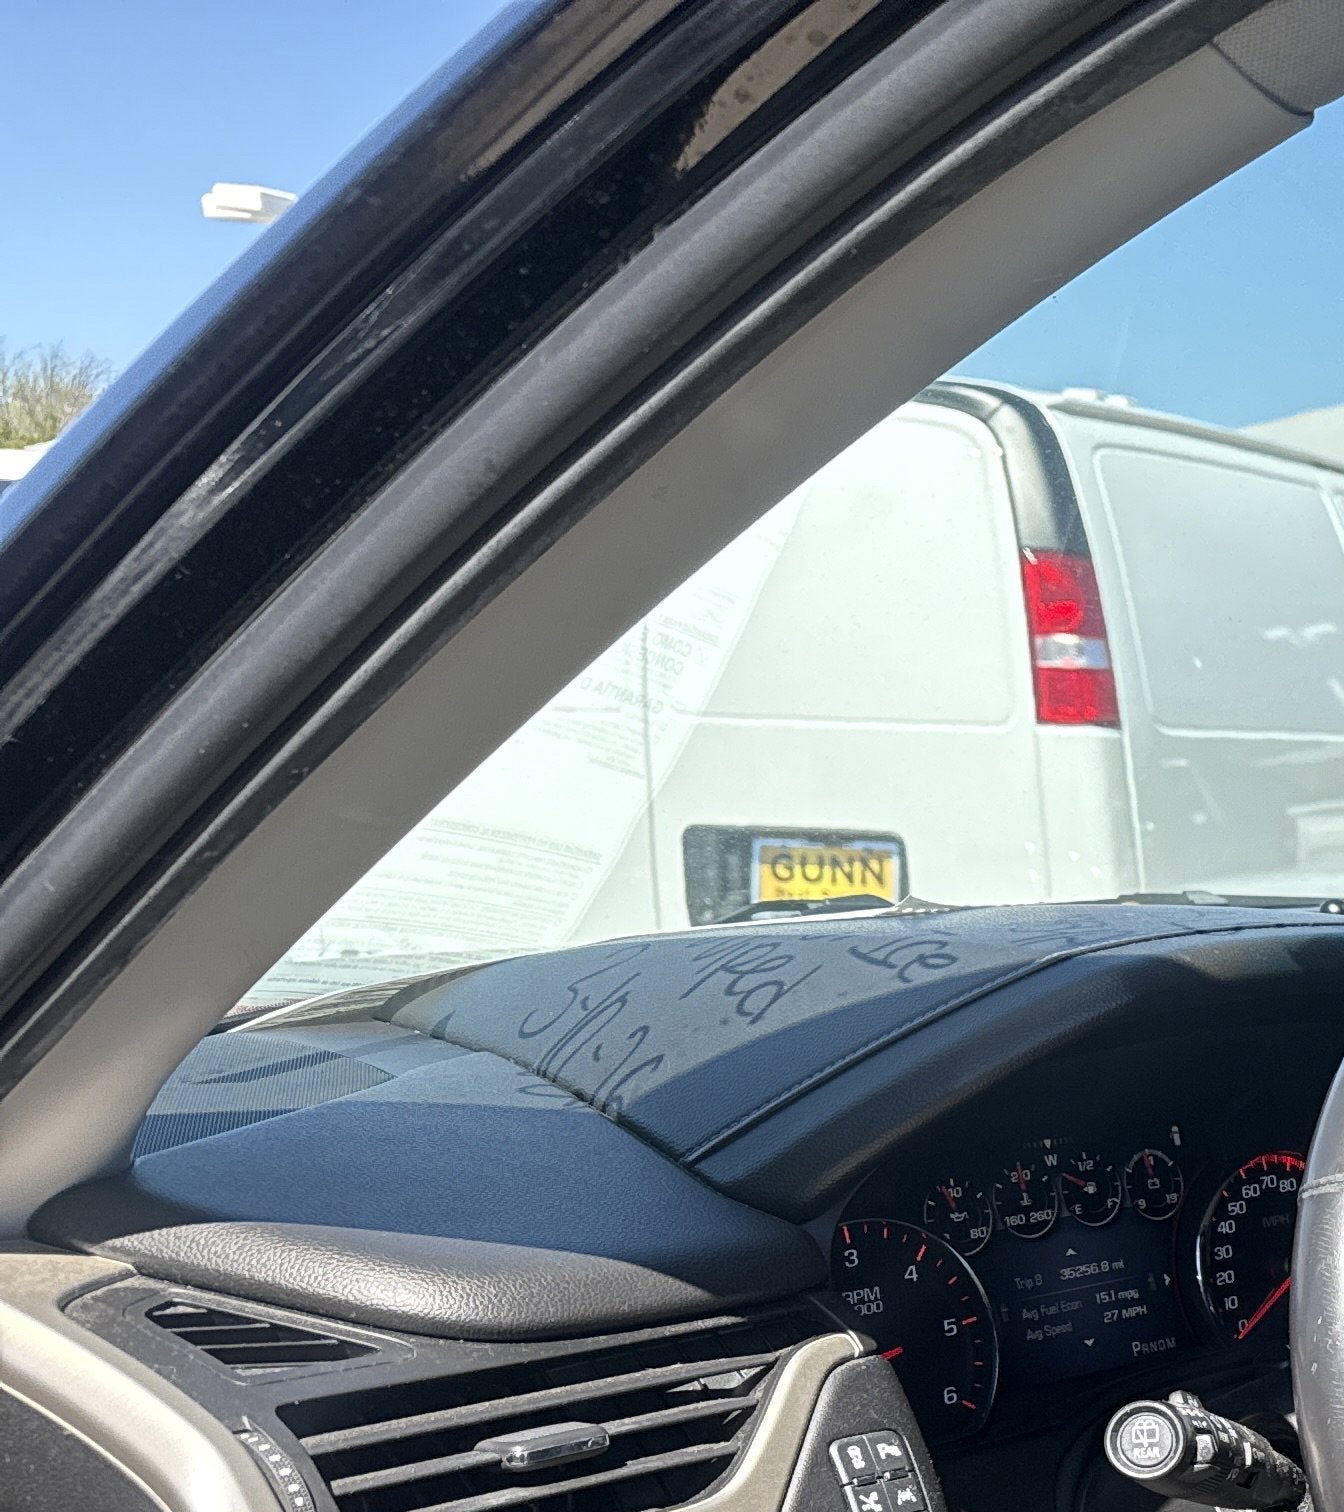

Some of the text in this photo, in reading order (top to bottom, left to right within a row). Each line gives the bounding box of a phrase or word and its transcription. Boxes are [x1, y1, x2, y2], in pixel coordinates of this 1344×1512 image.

[770, 852, 886, 887] GUNN
[1259, 1174, 1277, 1190] 70
[1279, 1177, 1297, 1193] 80
[1241, 1183, 1261, 1199] 60
[1029, 1208, 1053, 1223] 260
[1227, 1200, 1247, 1216] 50
[1004, 1213, 1027, 1227] 160
[1216, 1219, 1236, 1234] 40
[969, 1226, 987, 1240] 80
[843, 1249, 859, 1268] 3
[1213, 1244, 1233, 1261] 30
[903, 1264, 919, 1282] 4
[1216, 1270, 1235, 1286] 20
[1223, 1295, 1239, 1310] 10
[1103, 1309, 1119, 1323] 27
[1121, 1304, 1149, 1319] MPH
[943, 1317, 958, 1337] 5
[943, 1385, 958, 1405] 6
[1133, 1446, 1161, 1460] REAR
